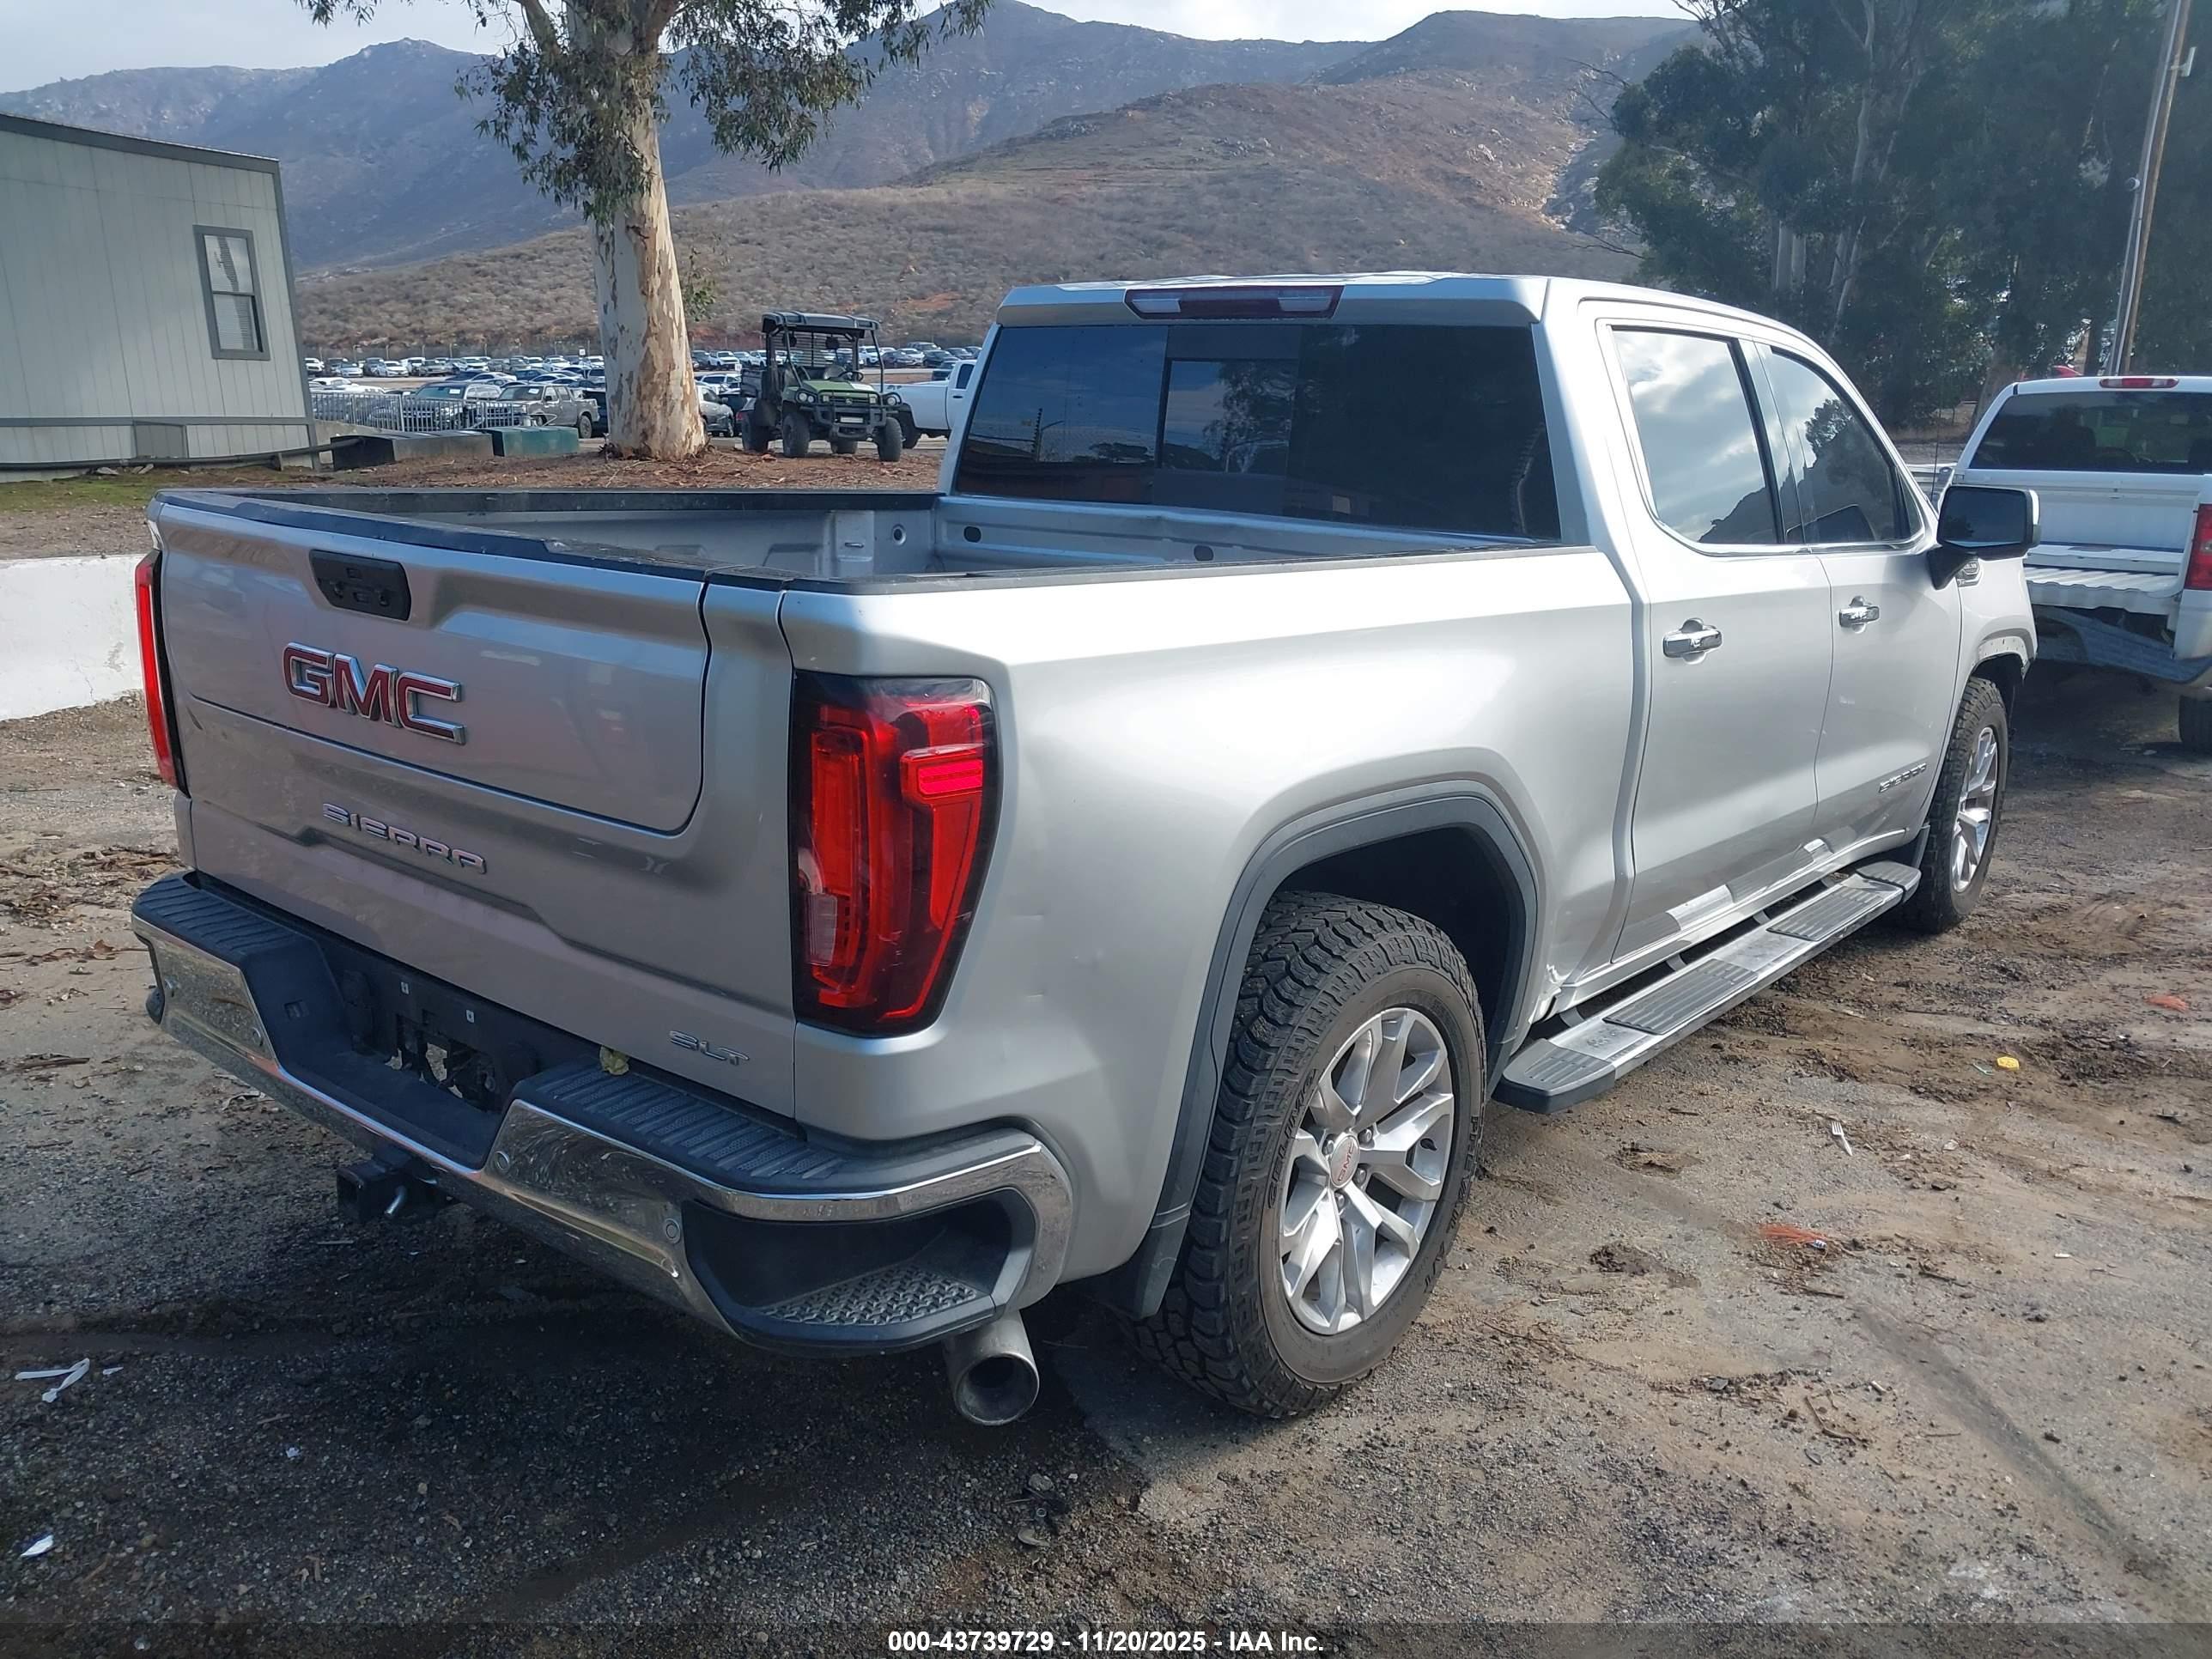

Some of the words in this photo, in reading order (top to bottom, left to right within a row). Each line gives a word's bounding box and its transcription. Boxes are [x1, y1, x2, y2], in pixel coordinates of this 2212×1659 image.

[283, 642, 466, 745] GMC
[323, 803, 487, 875] SIERRA
[670, 1030, 750, 1066] SLT
[1337, 1140, 1355, 1183] GMC
